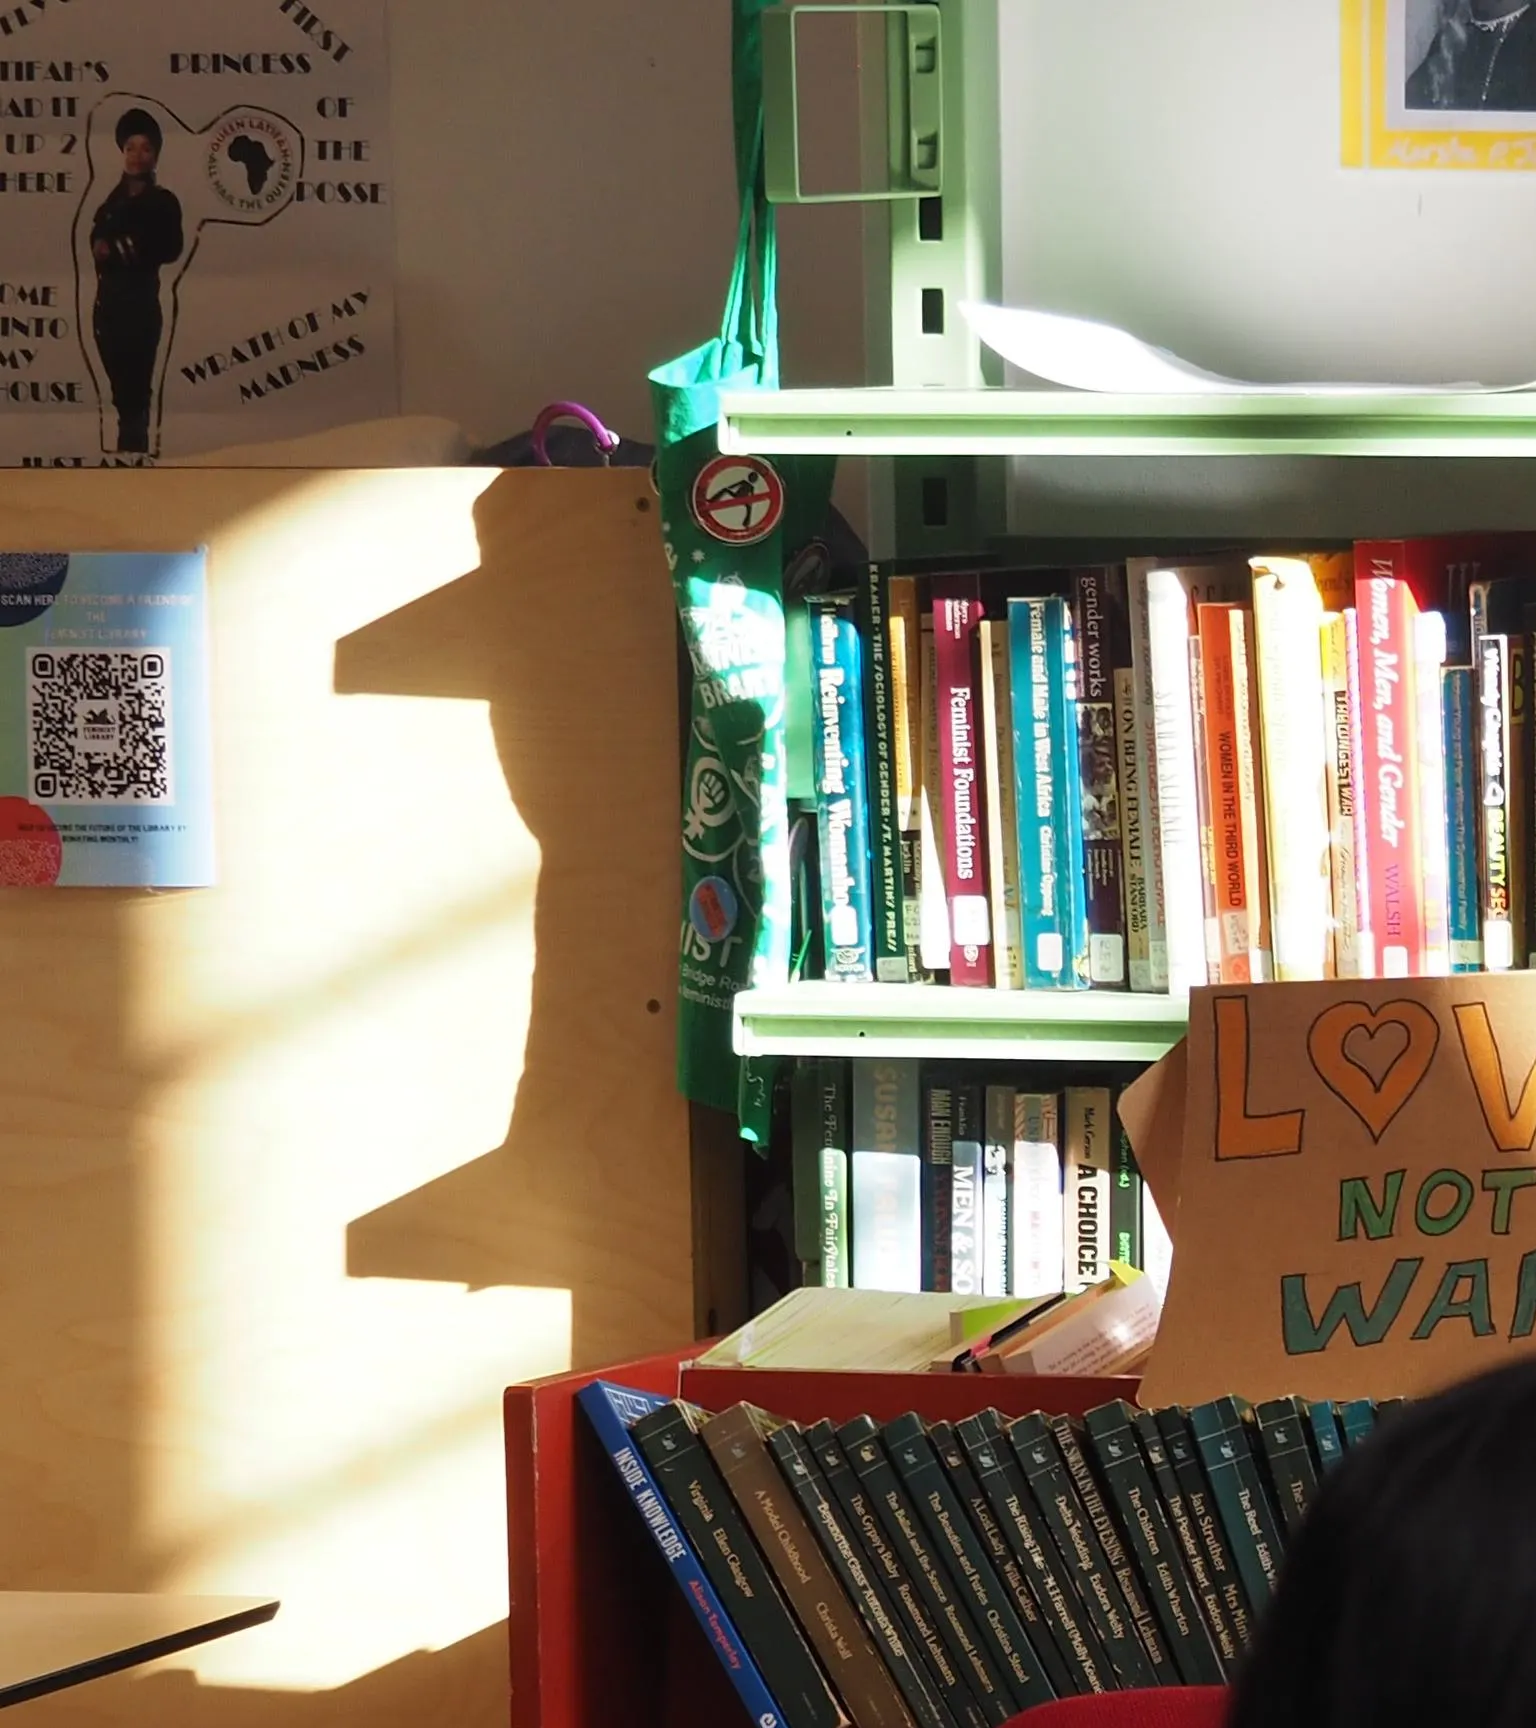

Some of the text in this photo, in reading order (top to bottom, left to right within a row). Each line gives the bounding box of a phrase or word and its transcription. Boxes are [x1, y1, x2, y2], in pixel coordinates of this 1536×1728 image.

[51, 97, 79, 118] IT
[170, 53, 312, 75] PRINCESS
[316, 97, 355, 118] OF
[5, 134, 77, 154] UP 2
[295, 182, 387, 204] POSSE
[314, 140, 371, 162] THE
[1, 316, 68, 339] INTO
[181, 286, 371, 385] WRATH OF MY
[238, 333, 366, 404] MADNESS
[867, 564, 891, 816] KRAMER THE SOCIOLOGY OF GENDER
[1080, 576, 1106, 697] gender works
[817, 667, 848, 794] Reinventing
[949, 687, 977, 878] Feminist Foundations
[1333, 695, 1354, 816] THE LONGEST WAR
[1366, 558, 1403, 937] Women, Men, and Gender WALSH
[1121, 709, 1141, 866] ON BEING FEMALE
[1218, 730, 1242, 906] WOMEN IN THE THIRD WORLD
[821, 1214, 840, 1288] Fairytales
[950, 1166, 975, 1227] MEN
[1075, 1164, 1097, 1275] A CHOICE
[611, 1446, 688, 1562] INSIDE KNOWLEDGE
[684, 1479, 757, 1601] Virginia Ellen Glasgow
[927, 1489, 945, 1512] The
[937, 1510, 967, 1555] Beauties
[959, 1553, 977, 1575] and
[969, 1573, 992, 1605] Furies
[1188, 1490, 1231, 1573] Jan Struther
[1054, 1495, 1127, 1641] Delta Wedding Eudora Welty
